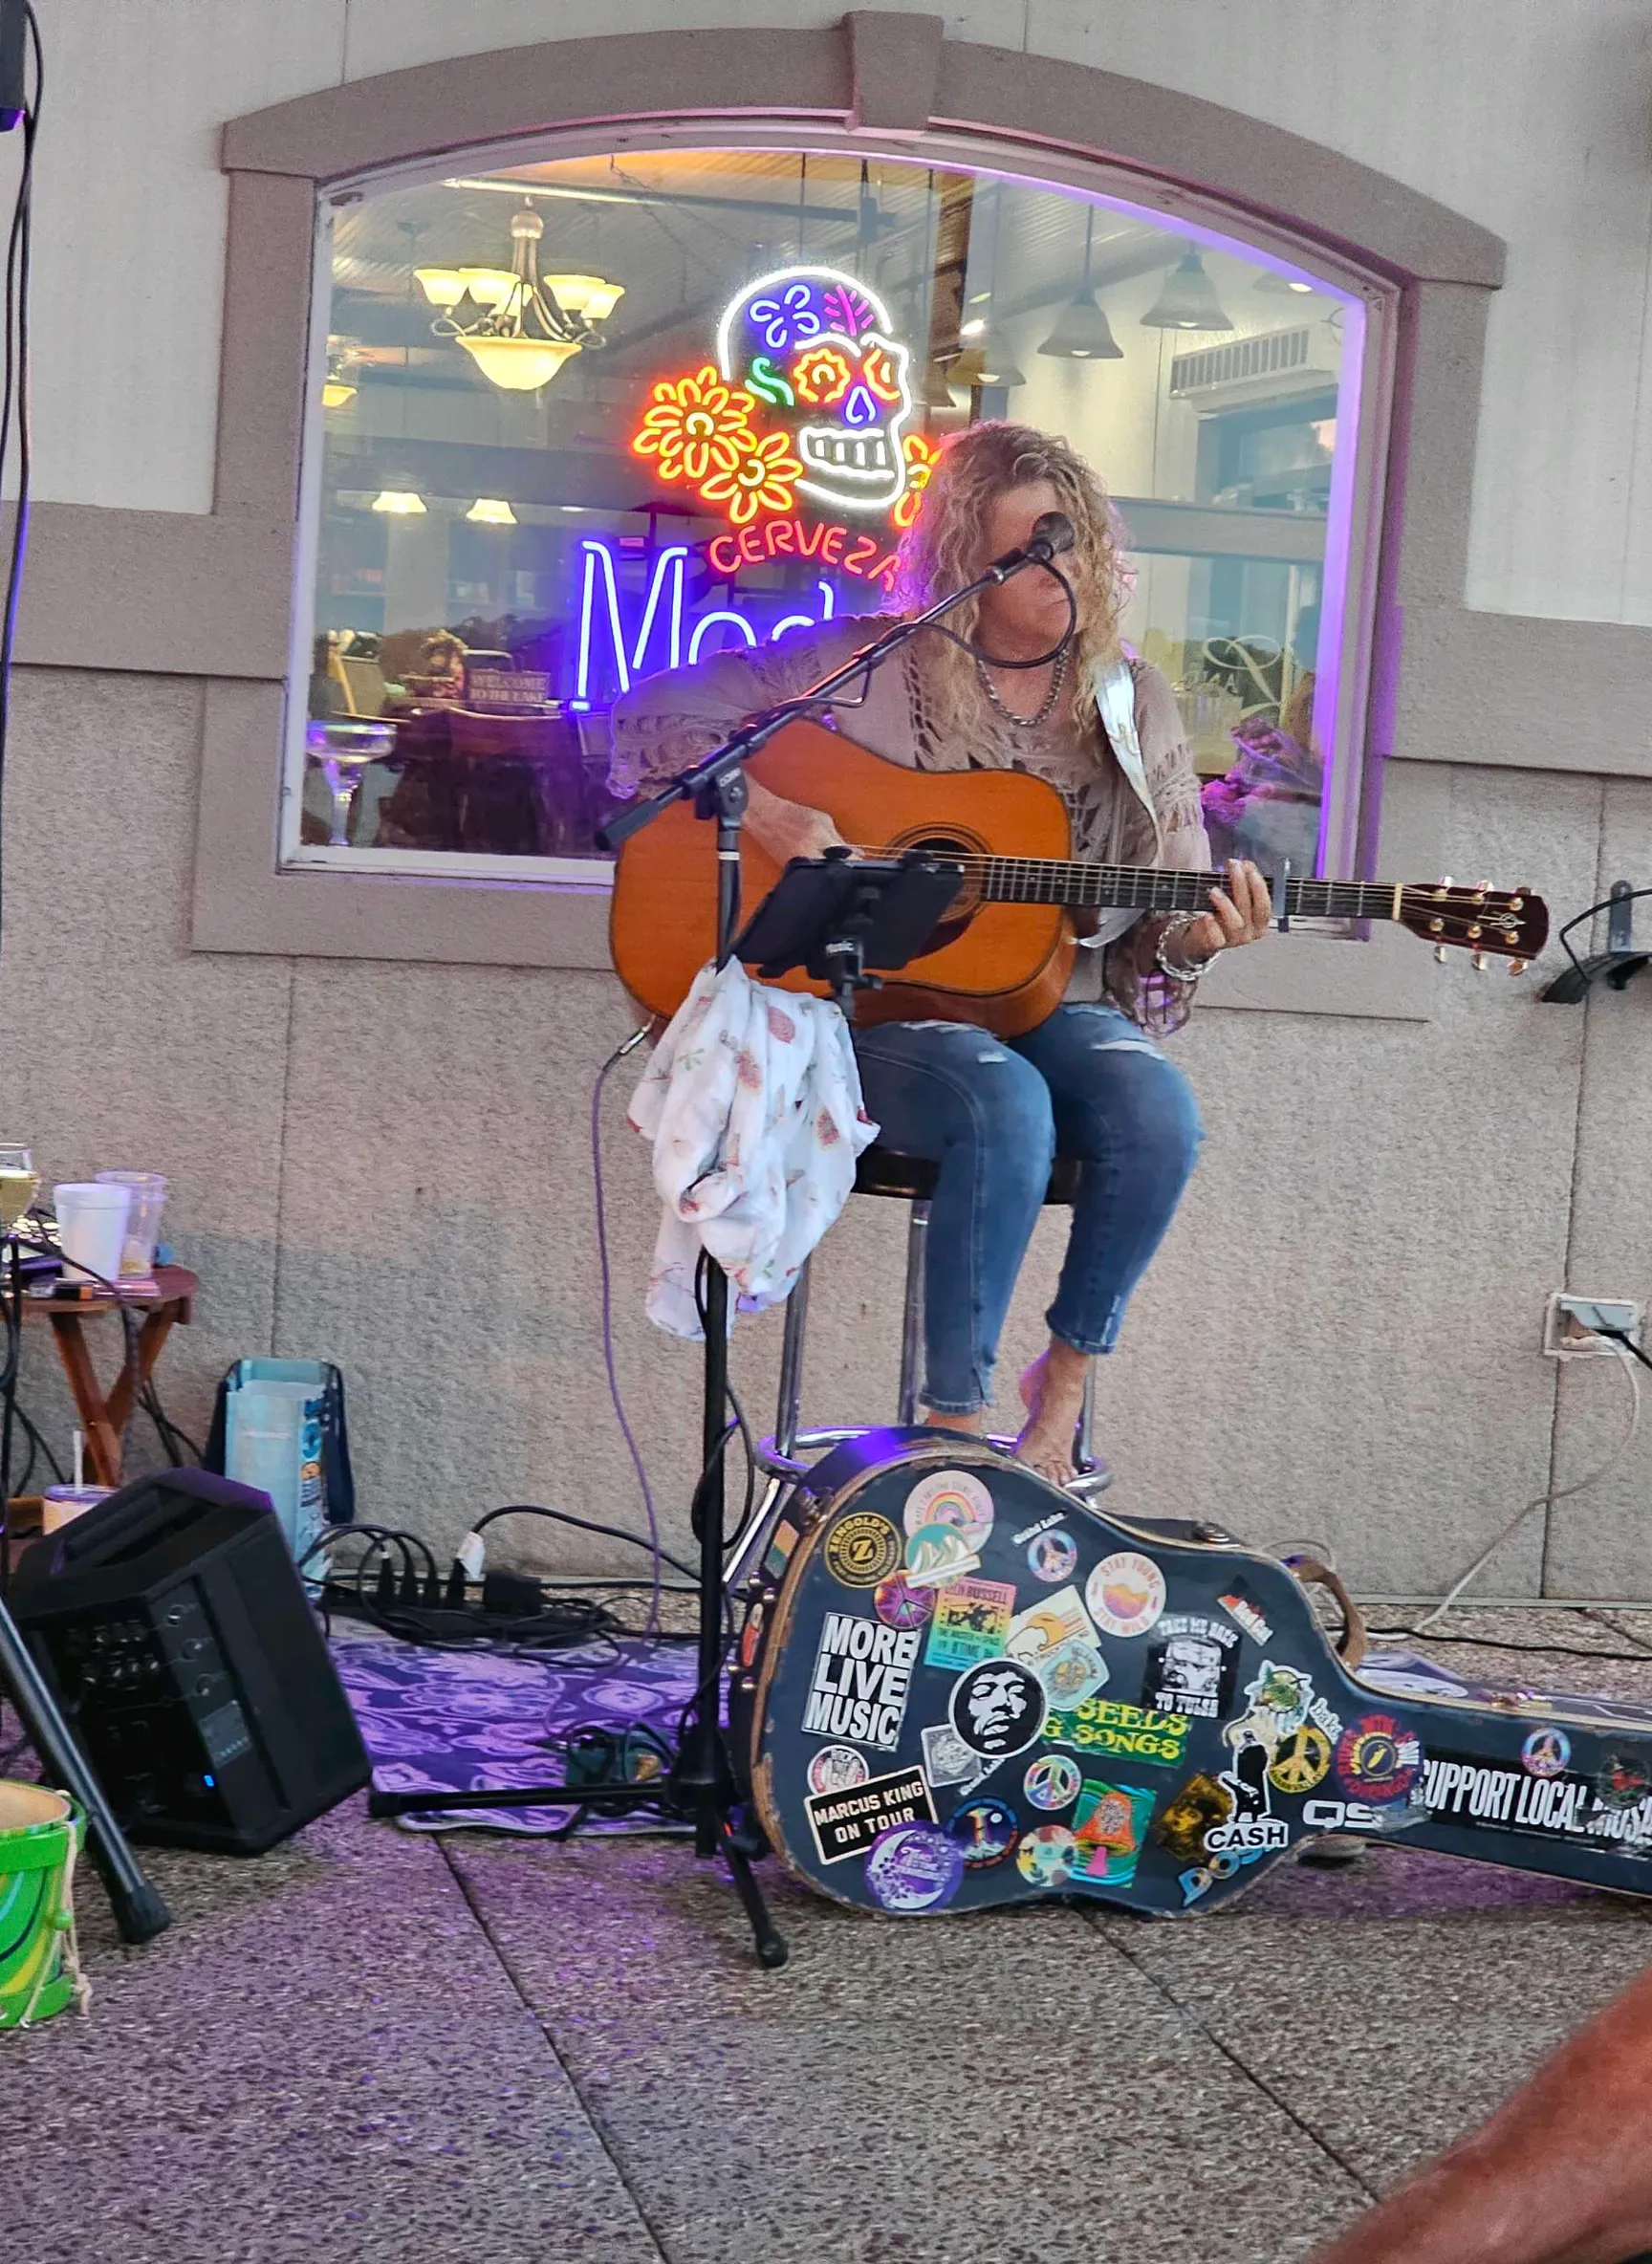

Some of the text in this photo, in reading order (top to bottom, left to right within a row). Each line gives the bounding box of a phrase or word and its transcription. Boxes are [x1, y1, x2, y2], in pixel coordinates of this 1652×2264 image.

[709, 519, 902, 593] CERVEZA
[821, 1615, 922, 1669] MORE
[815, 1653, 910, 1708] LIVE
[1154, 1691, 1220, 1718] TO TULSA
[804, 1691, 902, 1745] MUSIC
[1072, 1724, 1181, 1760] SONGS
[813, 1780, 924, 1826] MARCUS KING
[1422, 1759, 1522, 1821] UPPORT
[1514, 1775, 1588, 1834] LOCAL
[834, 1806, 916, 1844] ON TOUR
[1207, 1825, 1285, 1850] CASH
